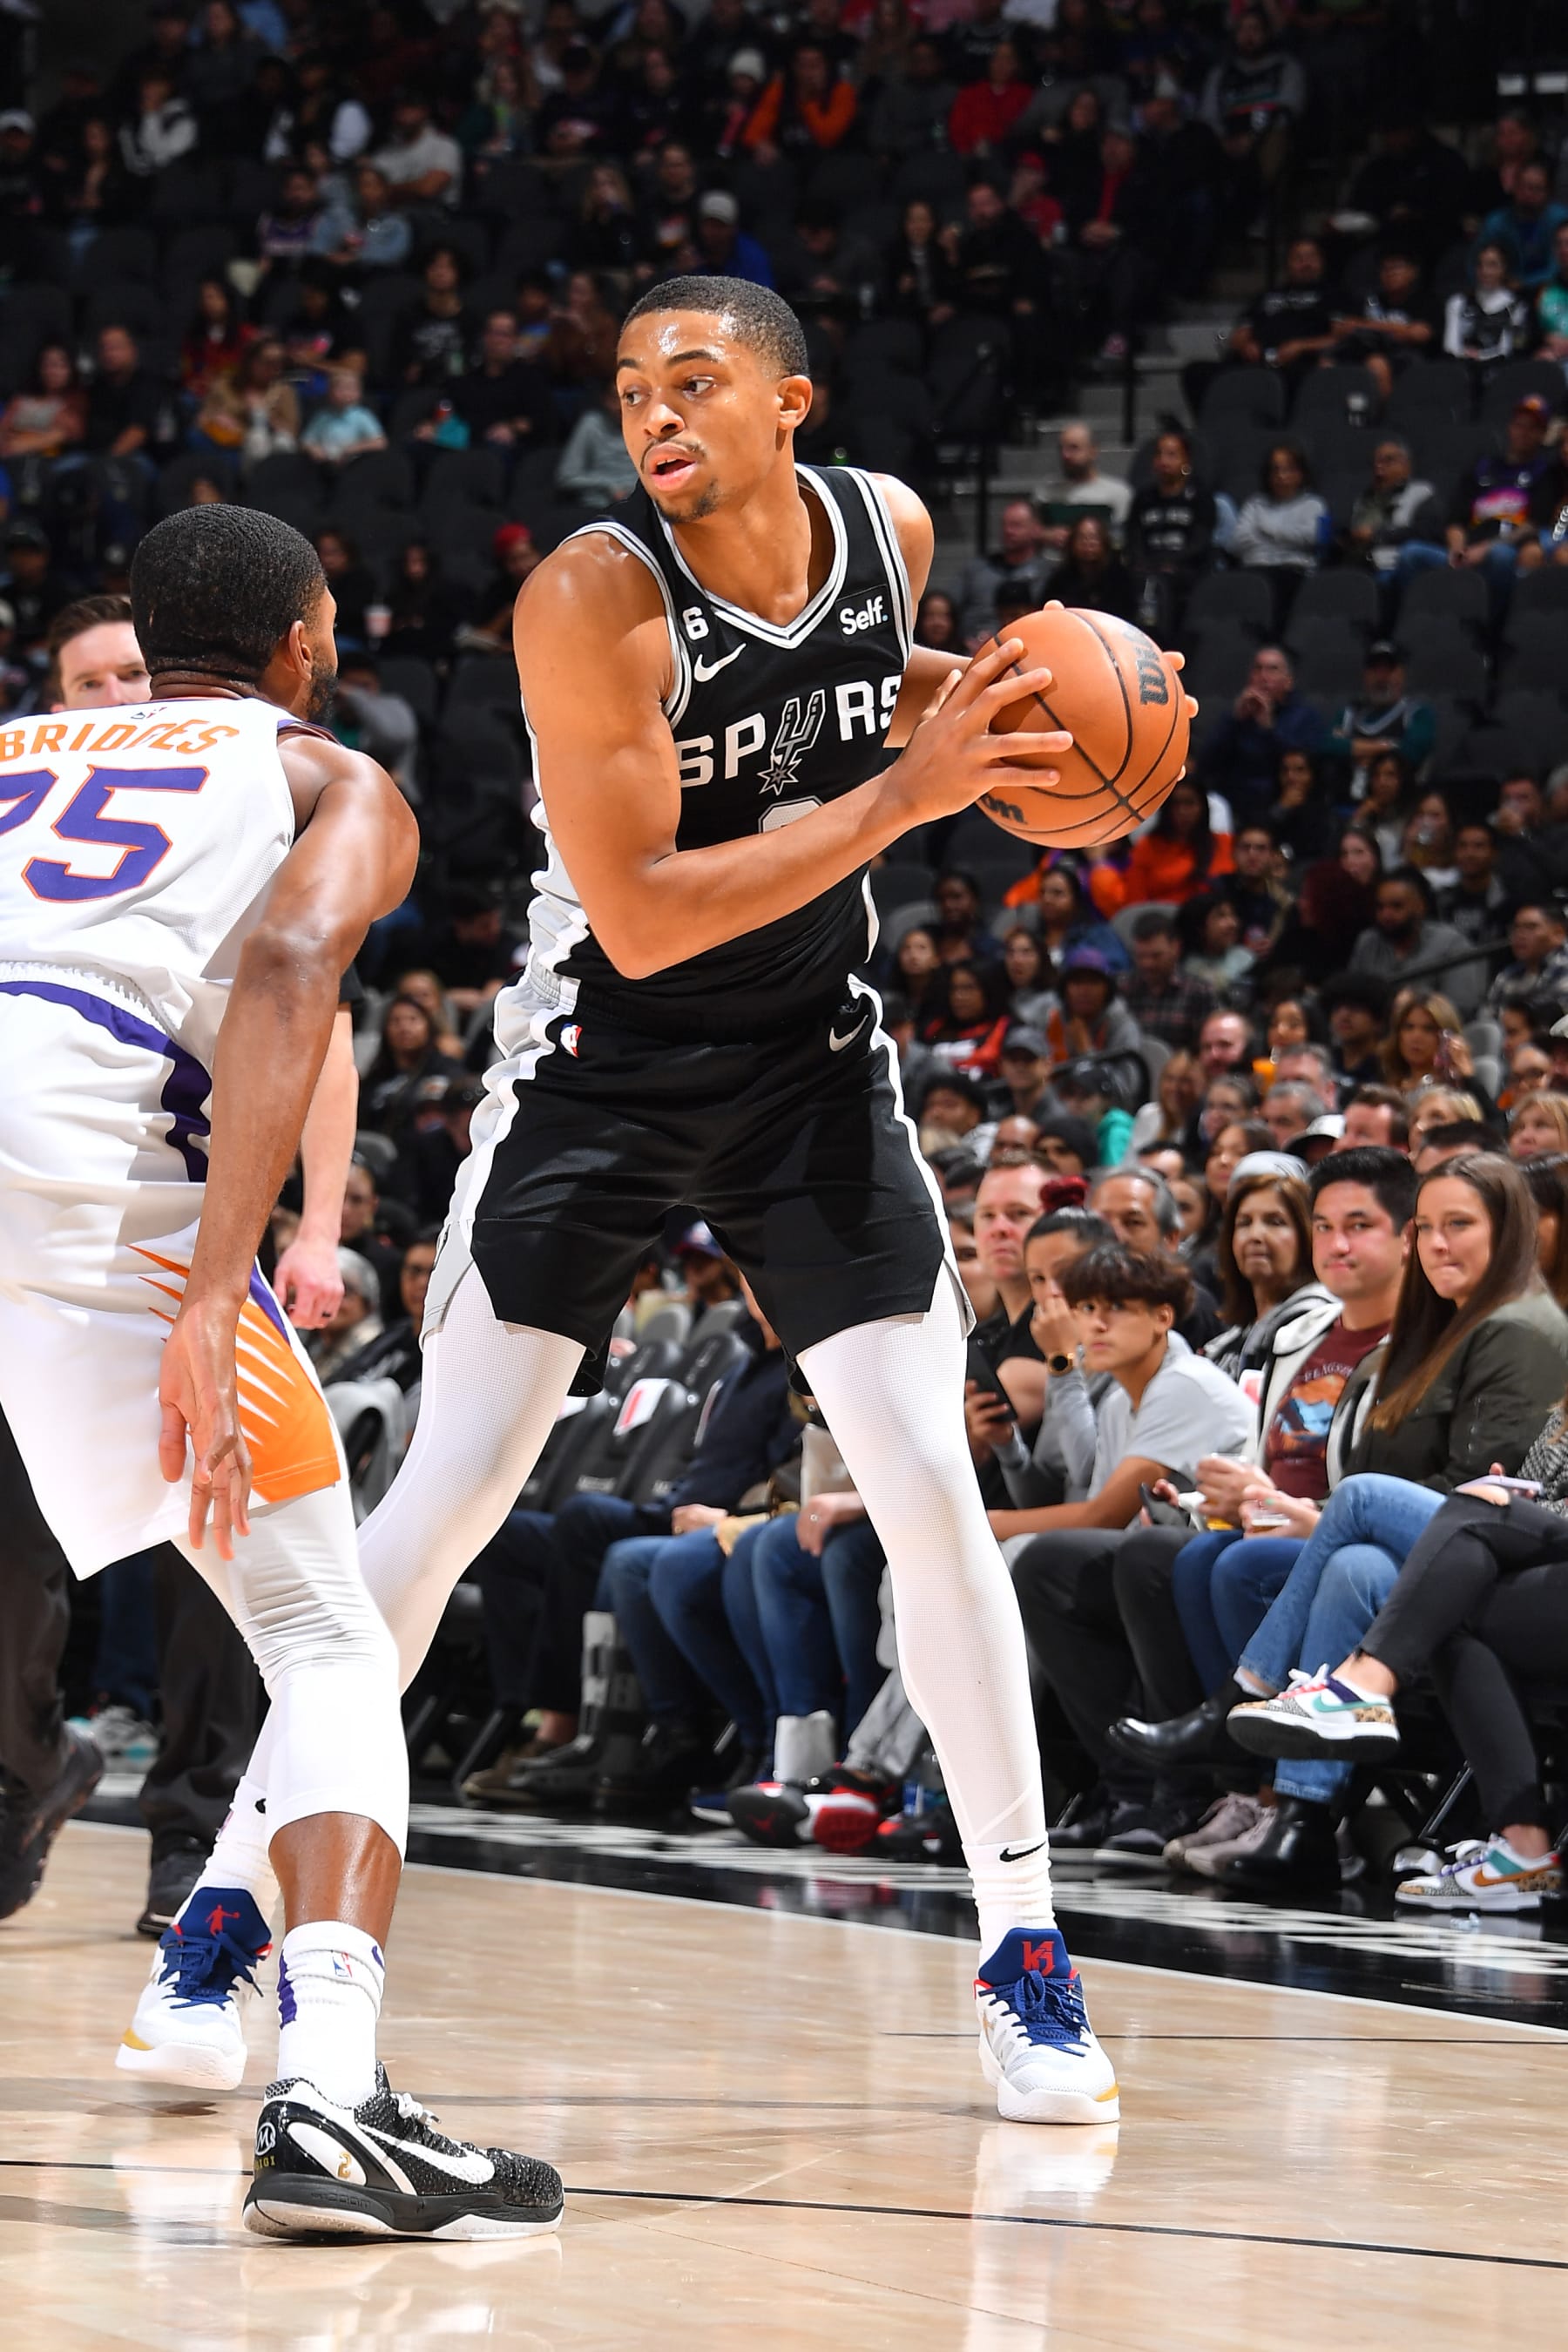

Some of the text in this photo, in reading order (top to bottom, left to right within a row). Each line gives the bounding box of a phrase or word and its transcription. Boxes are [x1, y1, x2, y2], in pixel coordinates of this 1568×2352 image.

[682, 606, 709, 640] 6
[839, 596, 888, 635] Self.
[338, 2152, 352, 2178] 2
